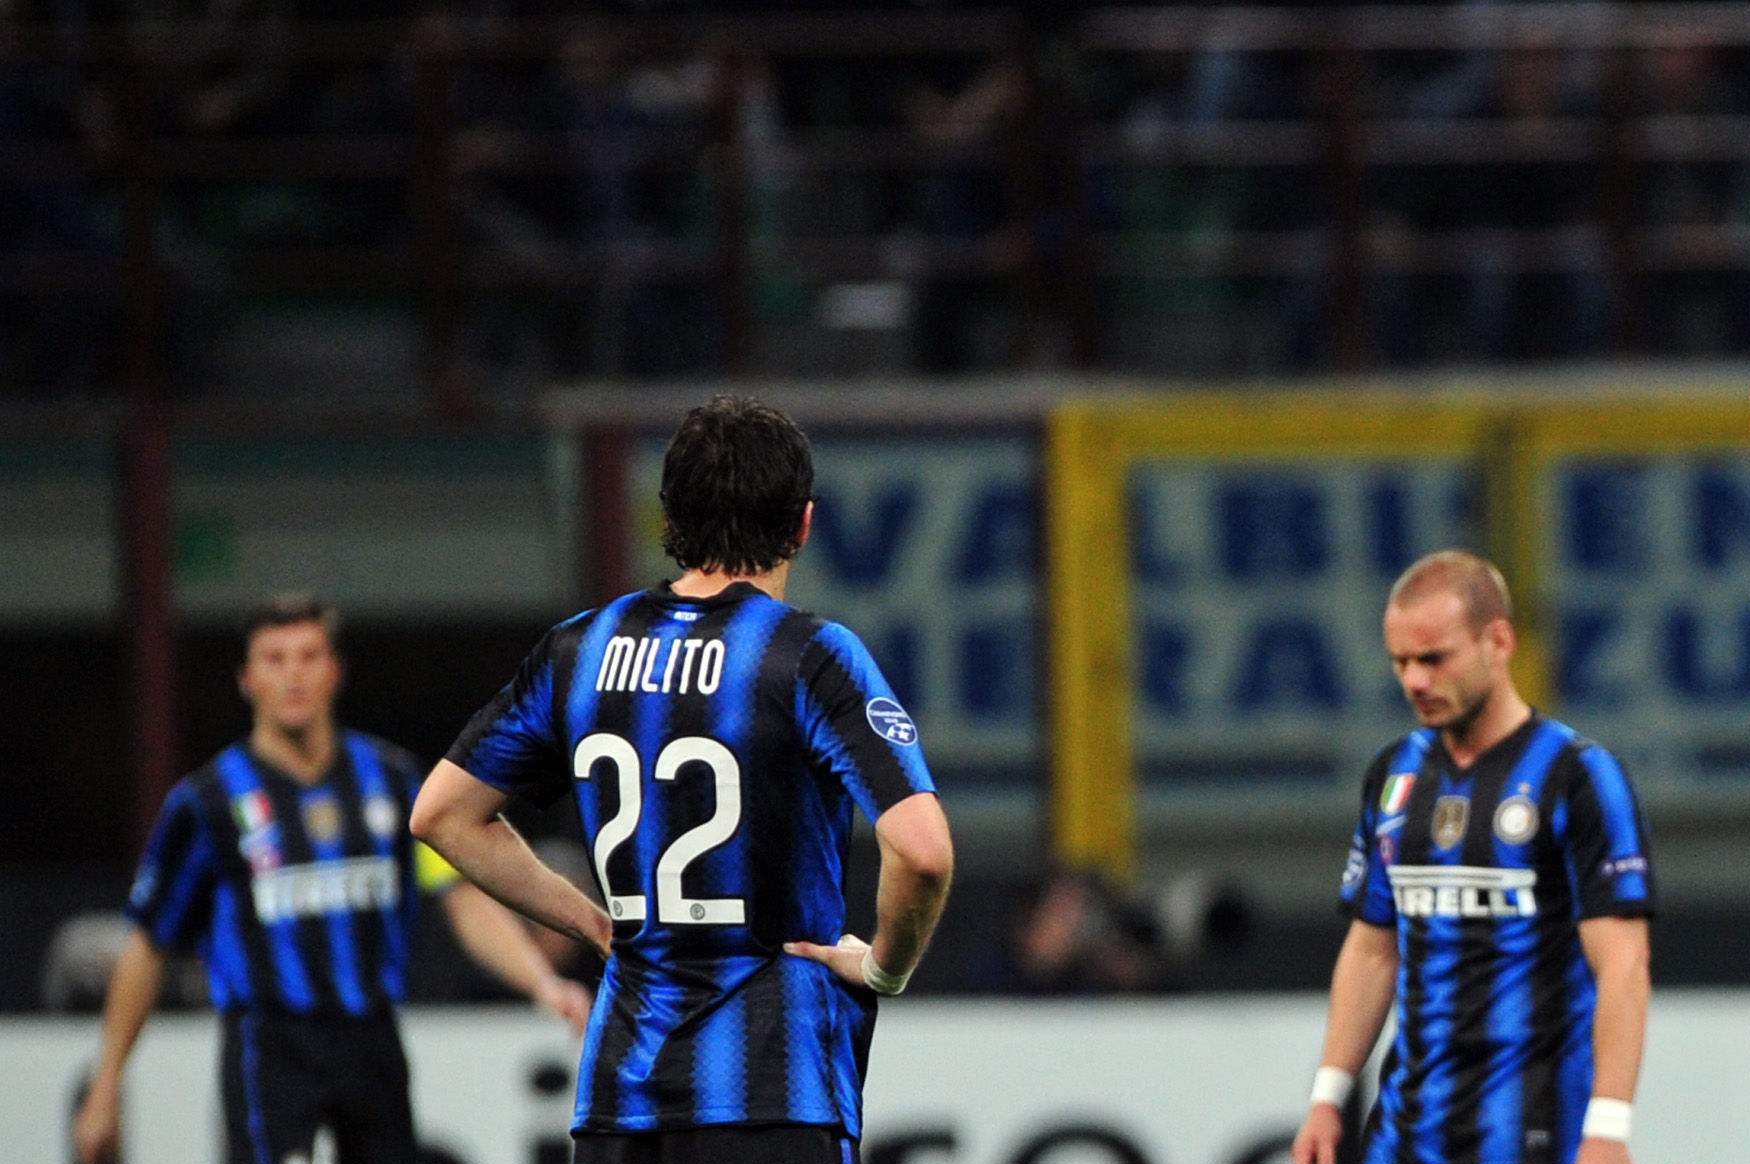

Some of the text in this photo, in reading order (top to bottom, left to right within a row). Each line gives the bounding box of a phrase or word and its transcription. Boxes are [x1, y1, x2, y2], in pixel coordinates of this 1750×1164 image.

[595, 635, 725, 695] MILITO
[573, 732, 746, 924] 22
[1386, 865, 1538, 918] RELLI
